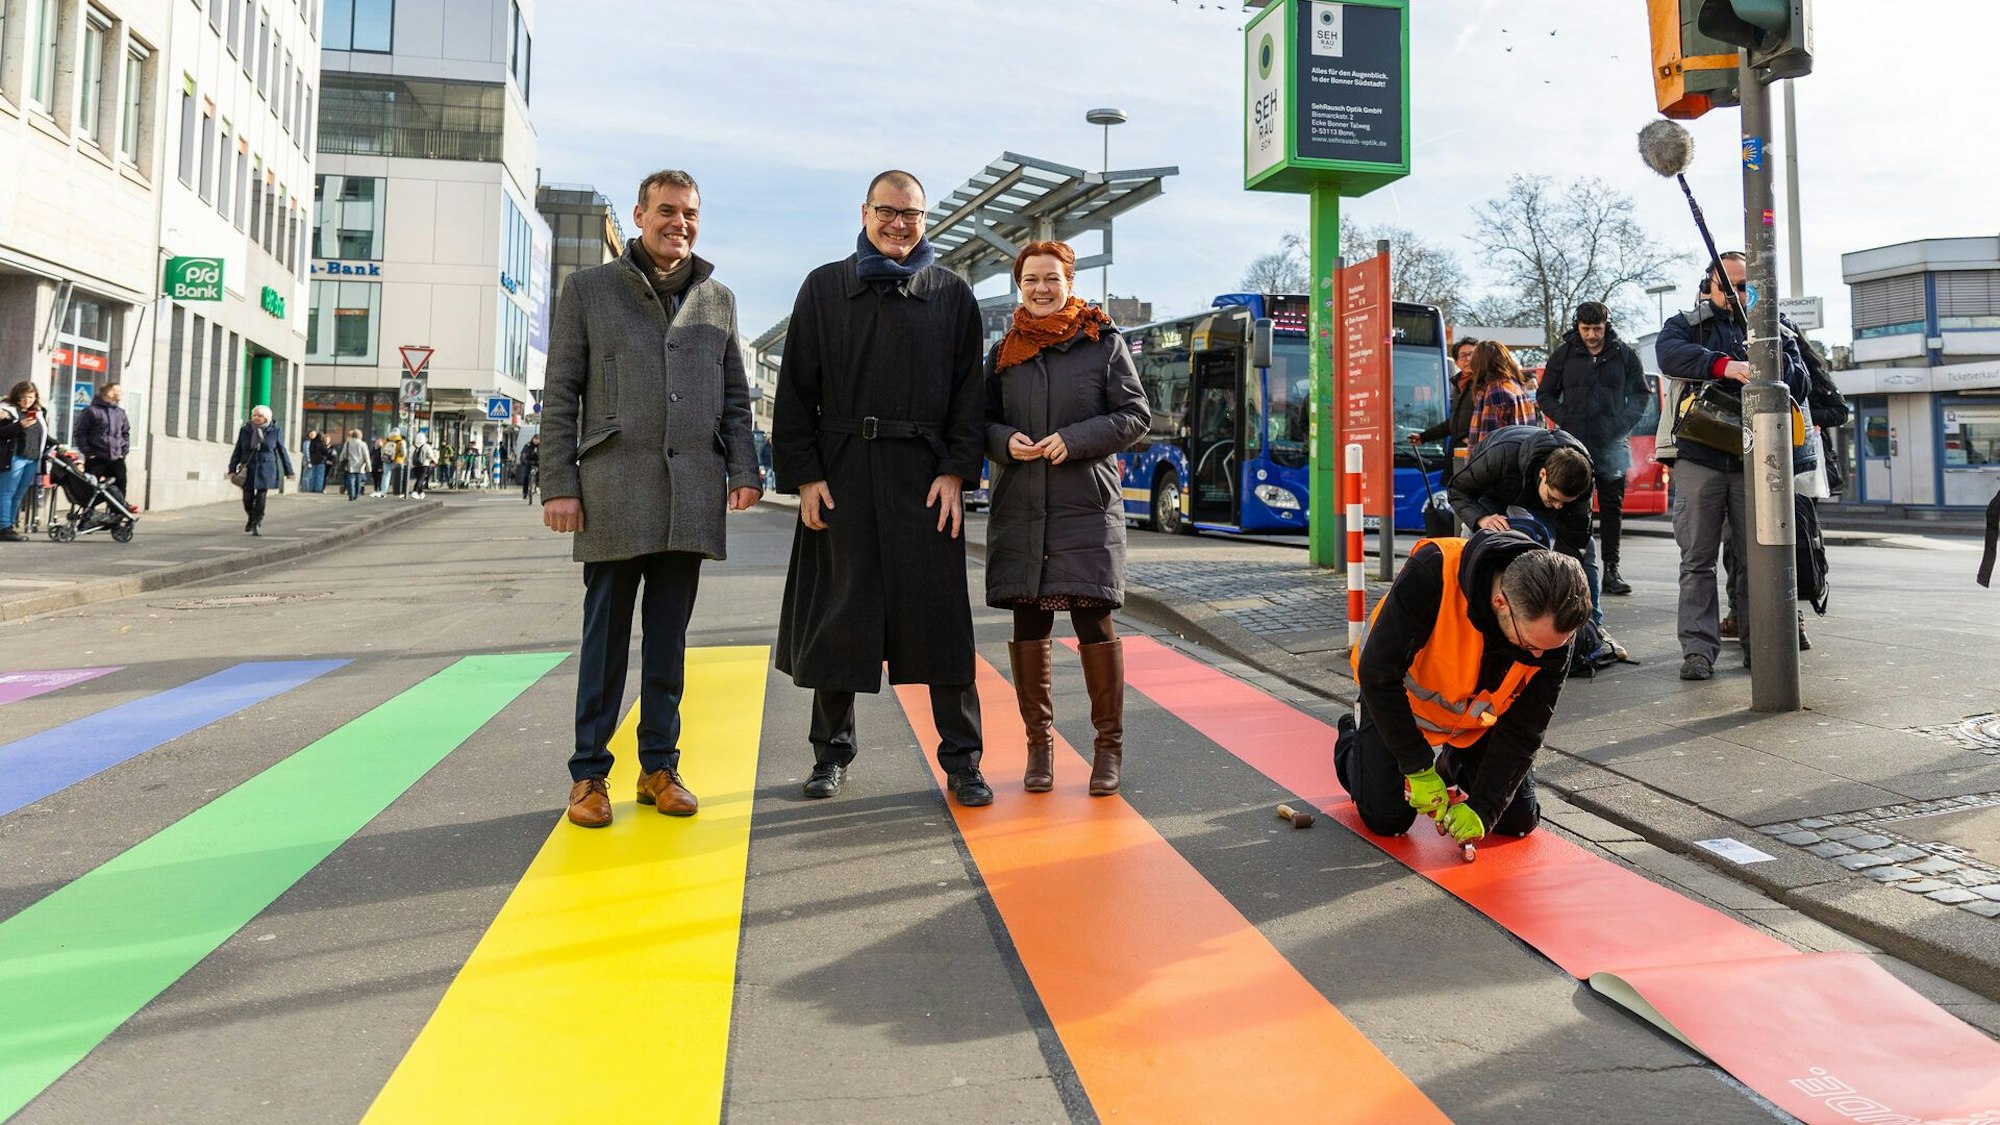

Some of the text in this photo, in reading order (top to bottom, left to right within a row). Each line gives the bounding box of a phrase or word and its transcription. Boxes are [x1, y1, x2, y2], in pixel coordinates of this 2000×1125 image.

[1317, 30, 1338, 40] SEH
[1311, 67, 1328, 75] Alles
[1352, 70, 1389, 79] Augenblick.
[1331, 77, 1353, 85] Bonner
[1354, 78, 1386, 88] Südstadt!
[1255, 88, 1277, 124] SEH
[1311, 103, 1382, 114] SehRausch Optik GmbH
[1311, 111, 1349, 120] Bismarckstr.
[1259, 118, 1274, 140] RAU
[1311, 127, 1337, 135] D-53113
[1327, 120, 1349, 128] Bonner
[1349, 122, 1371, 131] Talweg
[1311, 136, 1387, 147] www.sehrausch-optik.de
[175, 283, 218, 298] Bank
